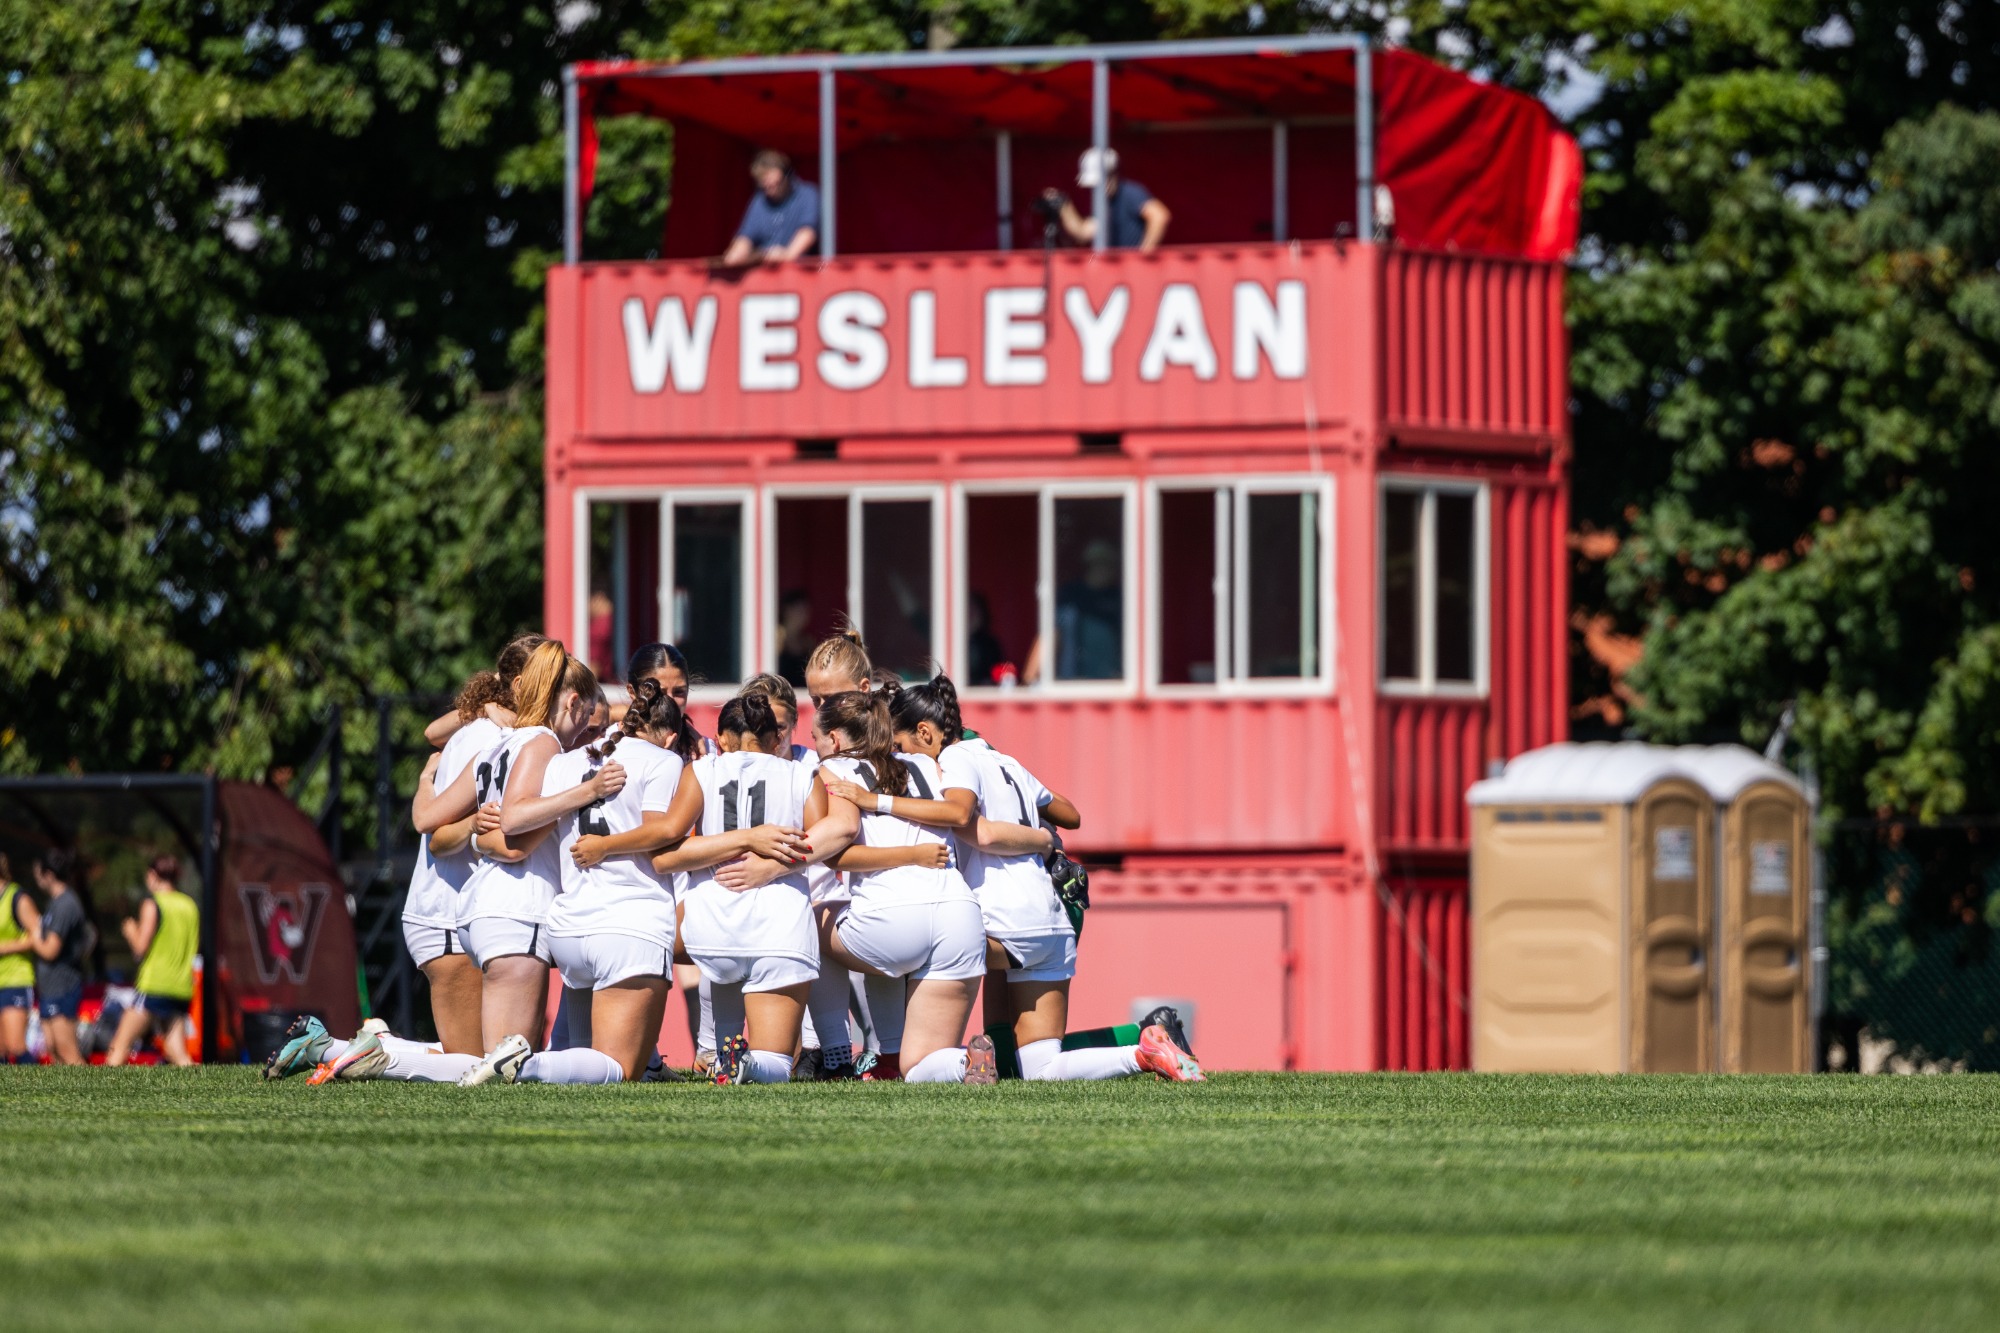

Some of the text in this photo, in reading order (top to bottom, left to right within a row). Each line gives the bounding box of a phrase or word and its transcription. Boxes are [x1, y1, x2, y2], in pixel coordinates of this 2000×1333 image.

[623, 281, 1308, 393] WESLEYAN
[709, 779, 766, 833] 11
[237, 882, 332, 985] W
